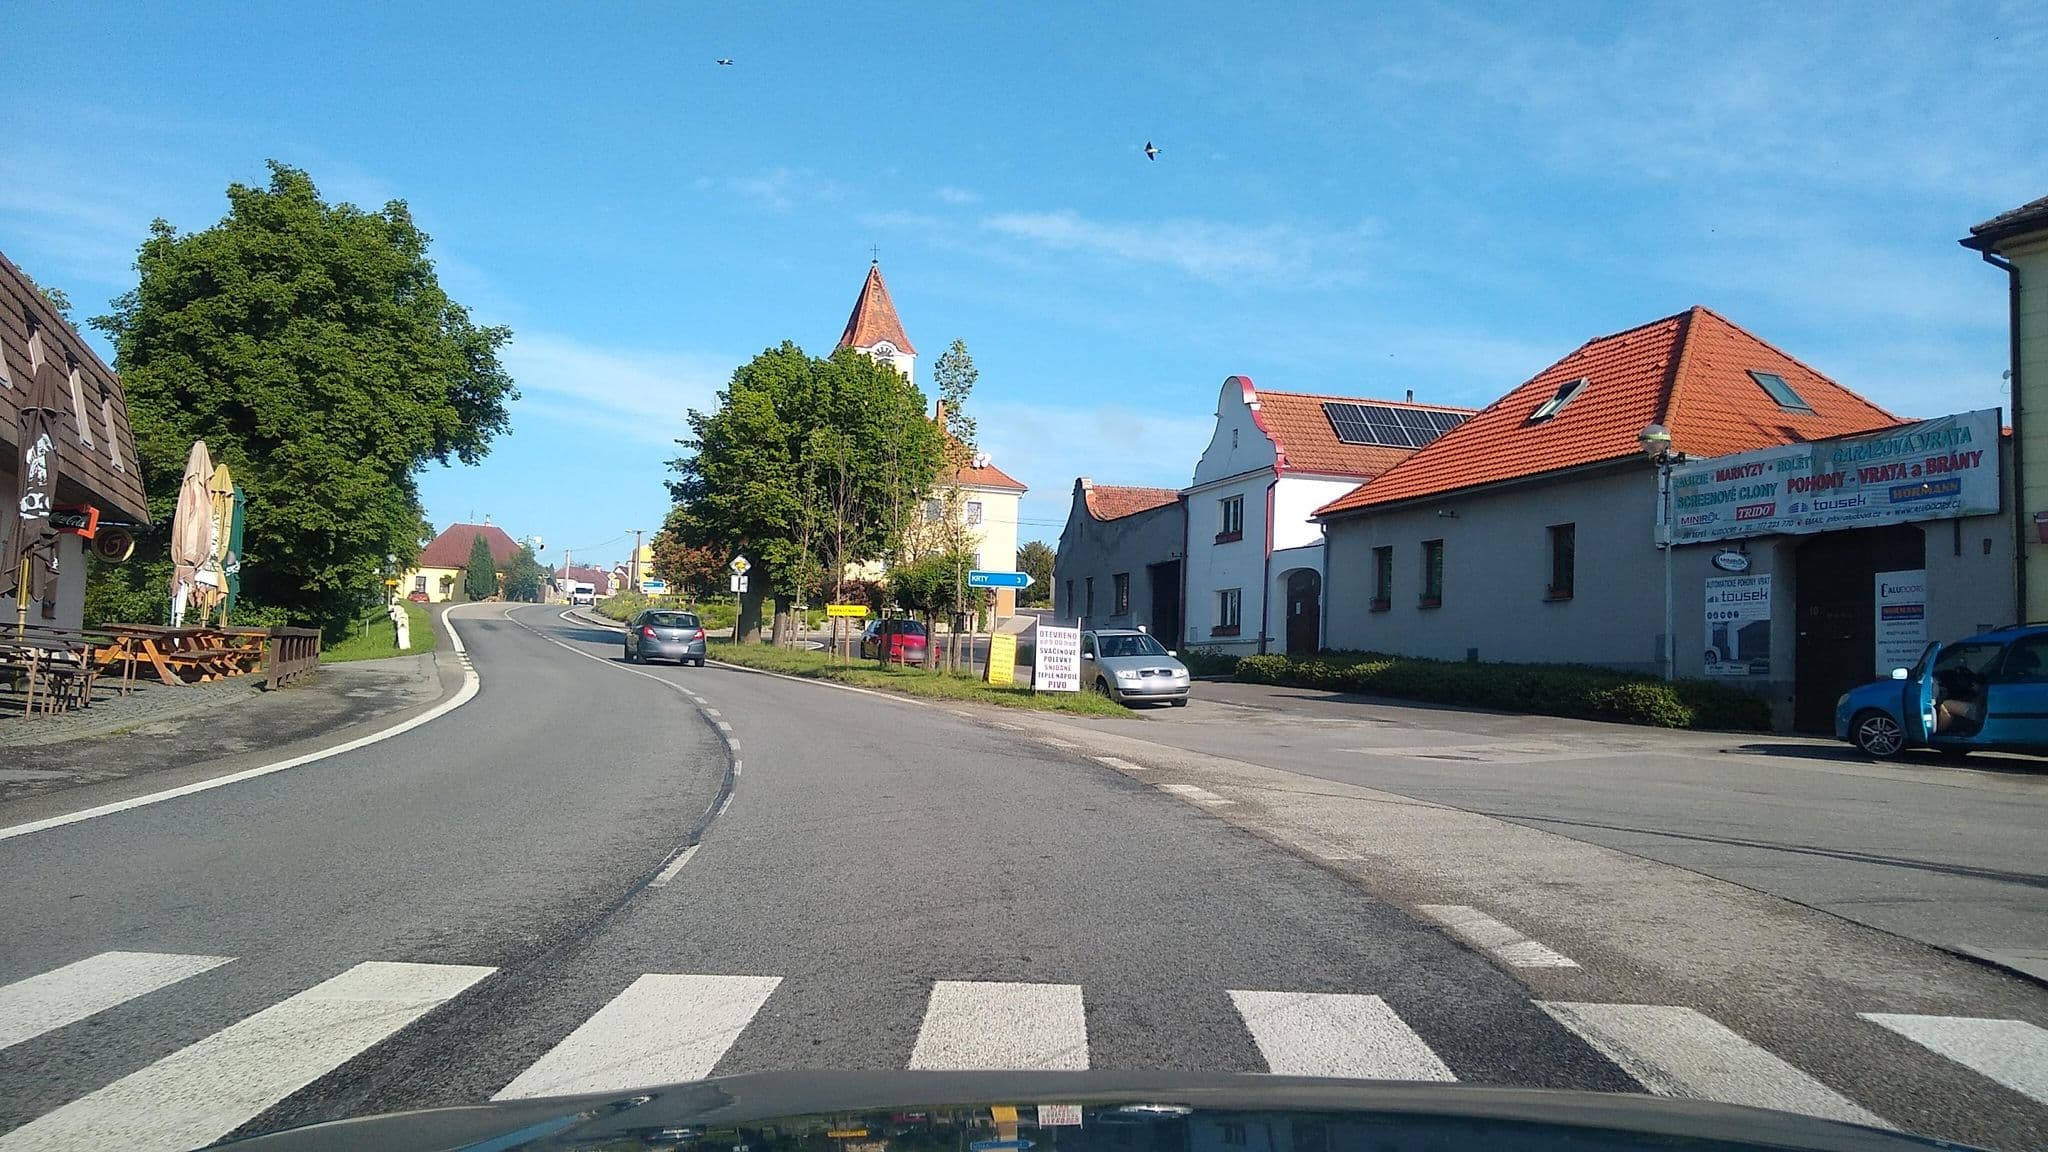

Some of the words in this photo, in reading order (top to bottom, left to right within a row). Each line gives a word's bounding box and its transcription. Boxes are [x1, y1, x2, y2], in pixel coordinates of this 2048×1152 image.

[1918, 426, 1972, 450] VRATA
[1716, 462, 1765, 482] MARKÝZY
[1787, 471, 1846, 494] POHONY
[1857, 463, 1907, 484] VRATA
[1926, 450, 1984, 474] BRÁNY
[1740, 482, 1778, 499] CLONY
[1814, 494, 1866, 511] tousek
[1738, 506, 1770, 519] TRIDO
[1721, 588, 1768, 602] tousek
[1048, 681, 1067, 689] PIVO
